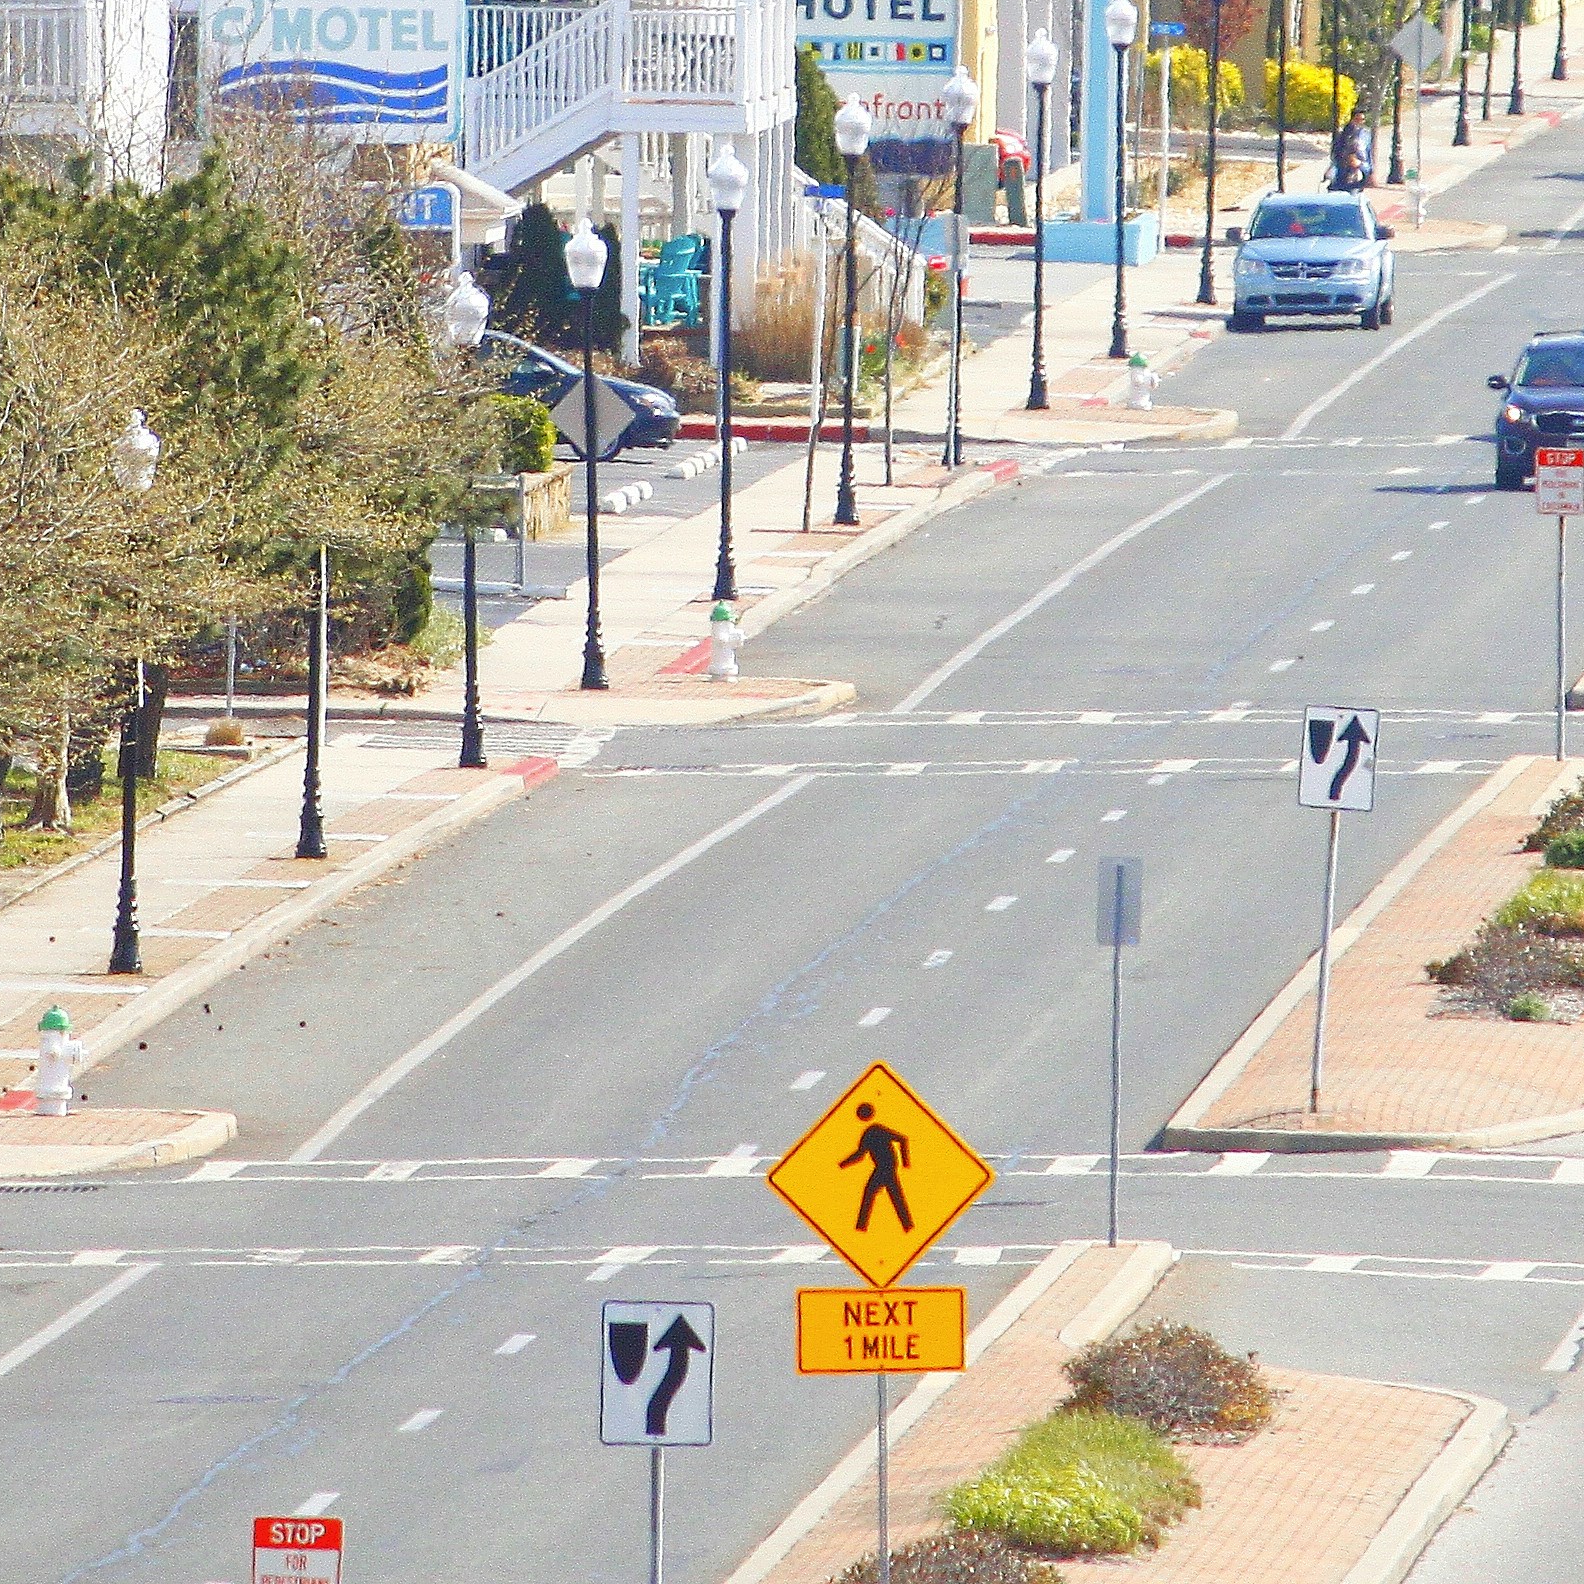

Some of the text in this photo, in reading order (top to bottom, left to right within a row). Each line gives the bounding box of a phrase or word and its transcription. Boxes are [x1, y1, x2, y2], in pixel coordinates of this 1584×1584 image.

[271, 6, 449, 53] MOTEL
[842, 1301, 917, 1328] NEXT
[845, 1335, 920, 1359] 1 MILE
[271, 1522, 326, 1544] STOP
